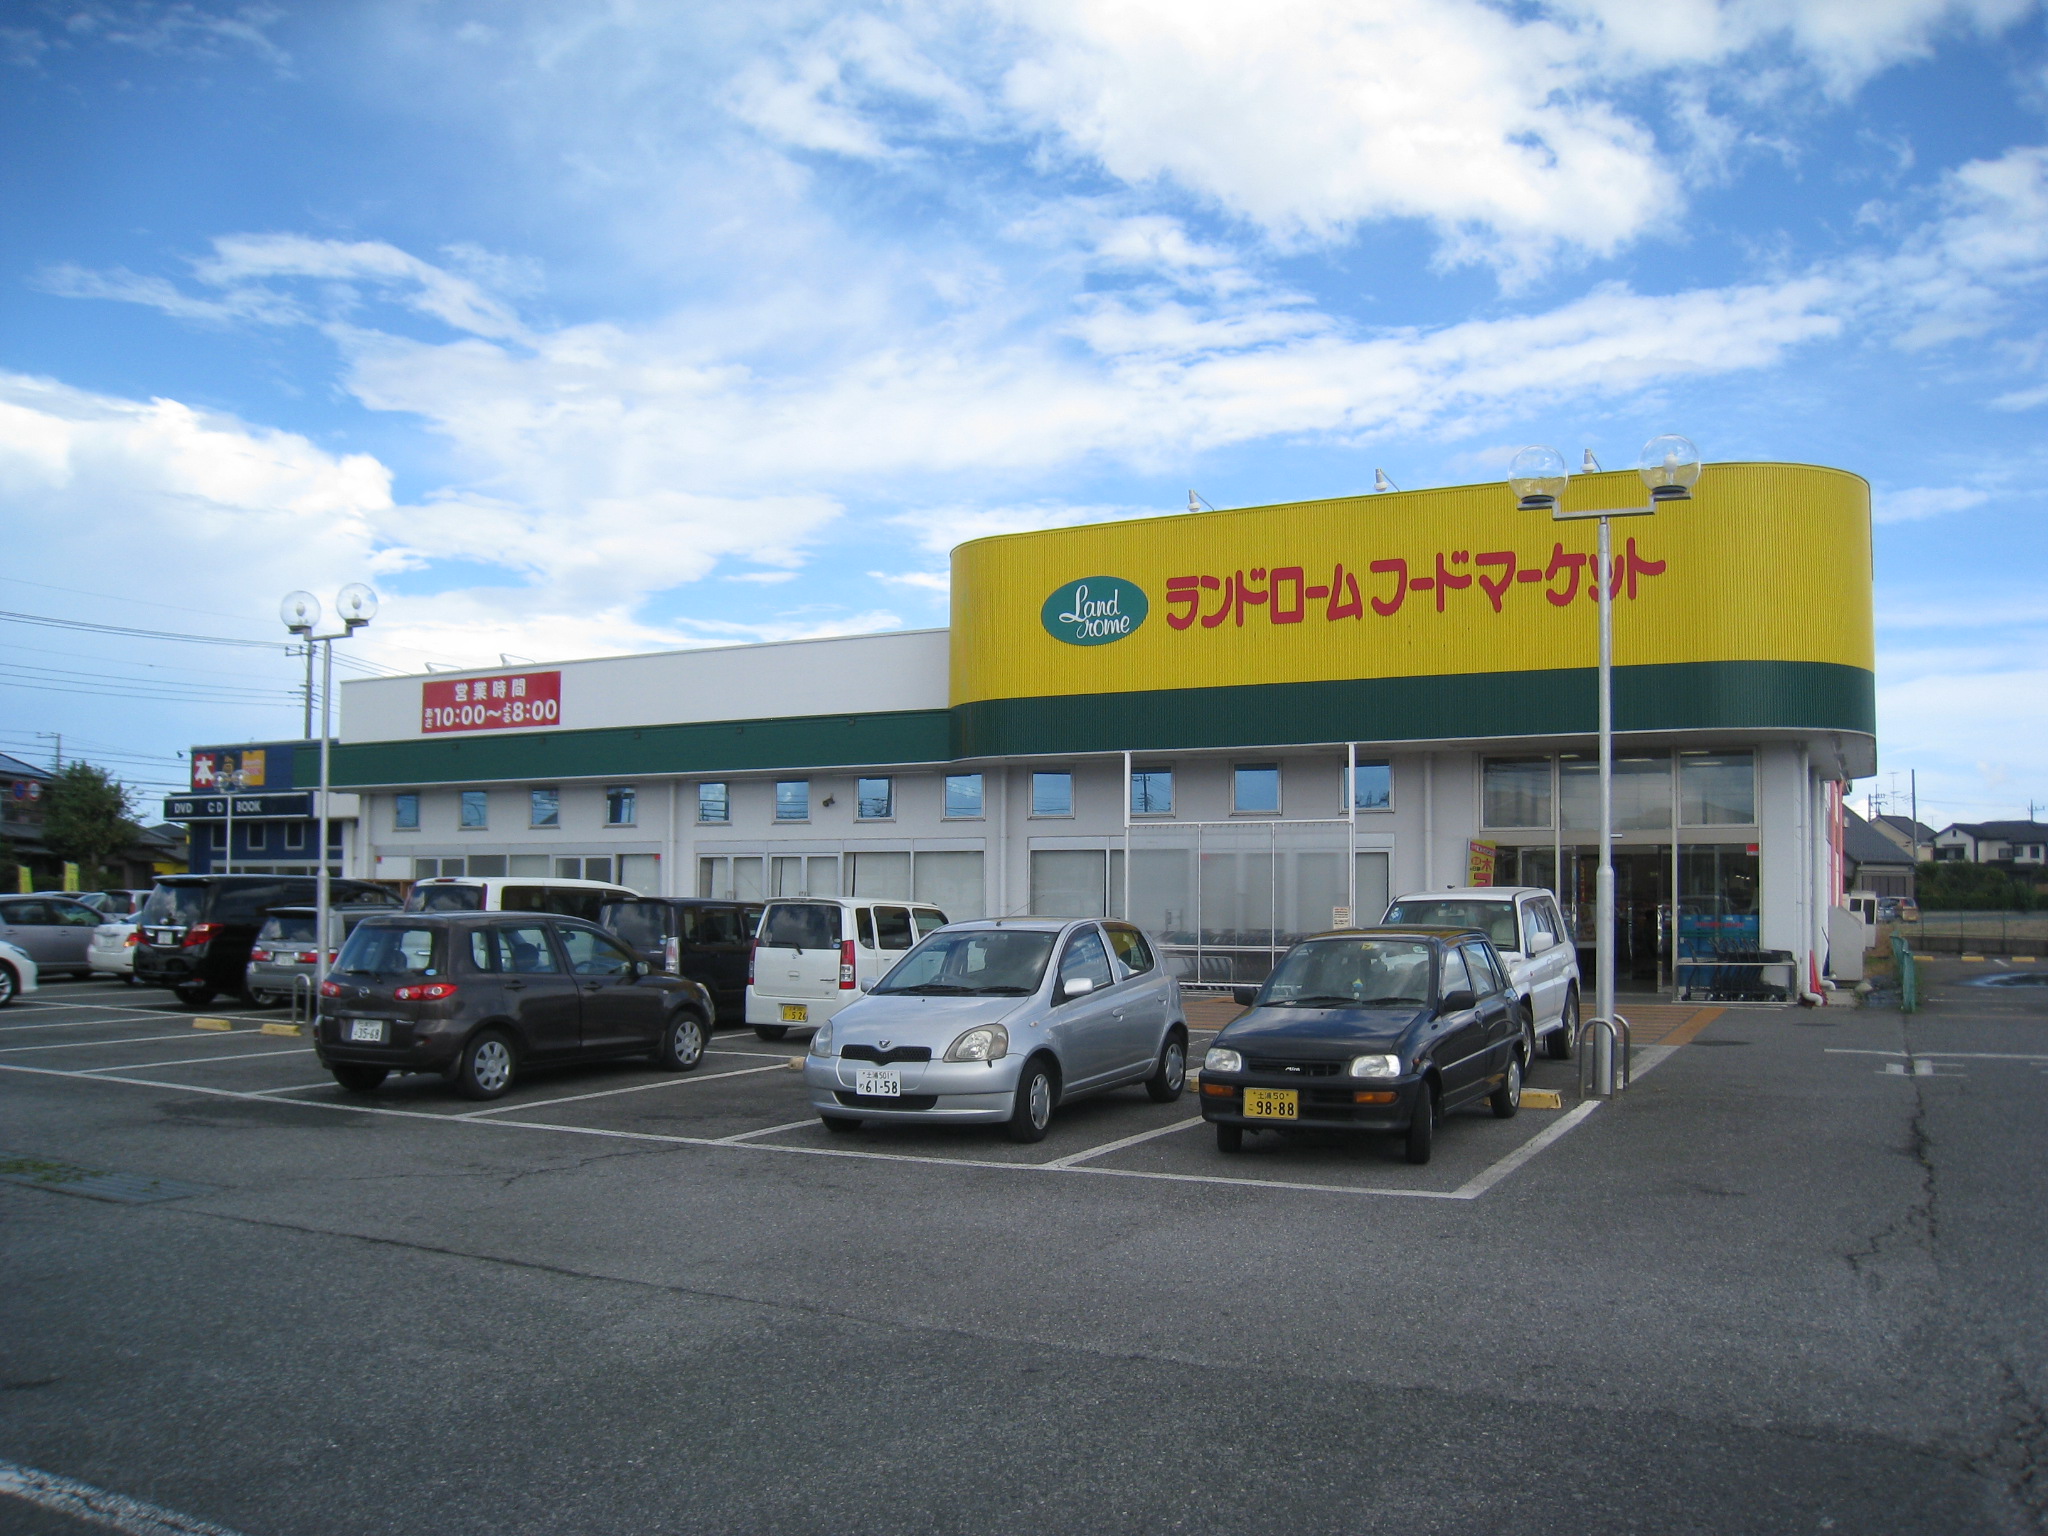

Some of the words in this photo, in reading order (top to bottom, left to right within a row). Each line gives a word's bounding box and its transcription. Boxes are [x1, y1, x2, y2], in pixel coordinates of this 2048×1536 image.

[1059, 584, 1121, 623] Land
[1076, 615, 1130, 639] rome
[455, 678, 526, 702] 営業時間
[512, 699, 557, 722] 8:00
[194, 756, 214, 785] 本
[174, 802, 193, 813] DVD
[236, 801, 262, 812] BOOK
[866, 1080, 898, 1094] 61-58
[1256, 1101, 1294, 1116] 98-88
